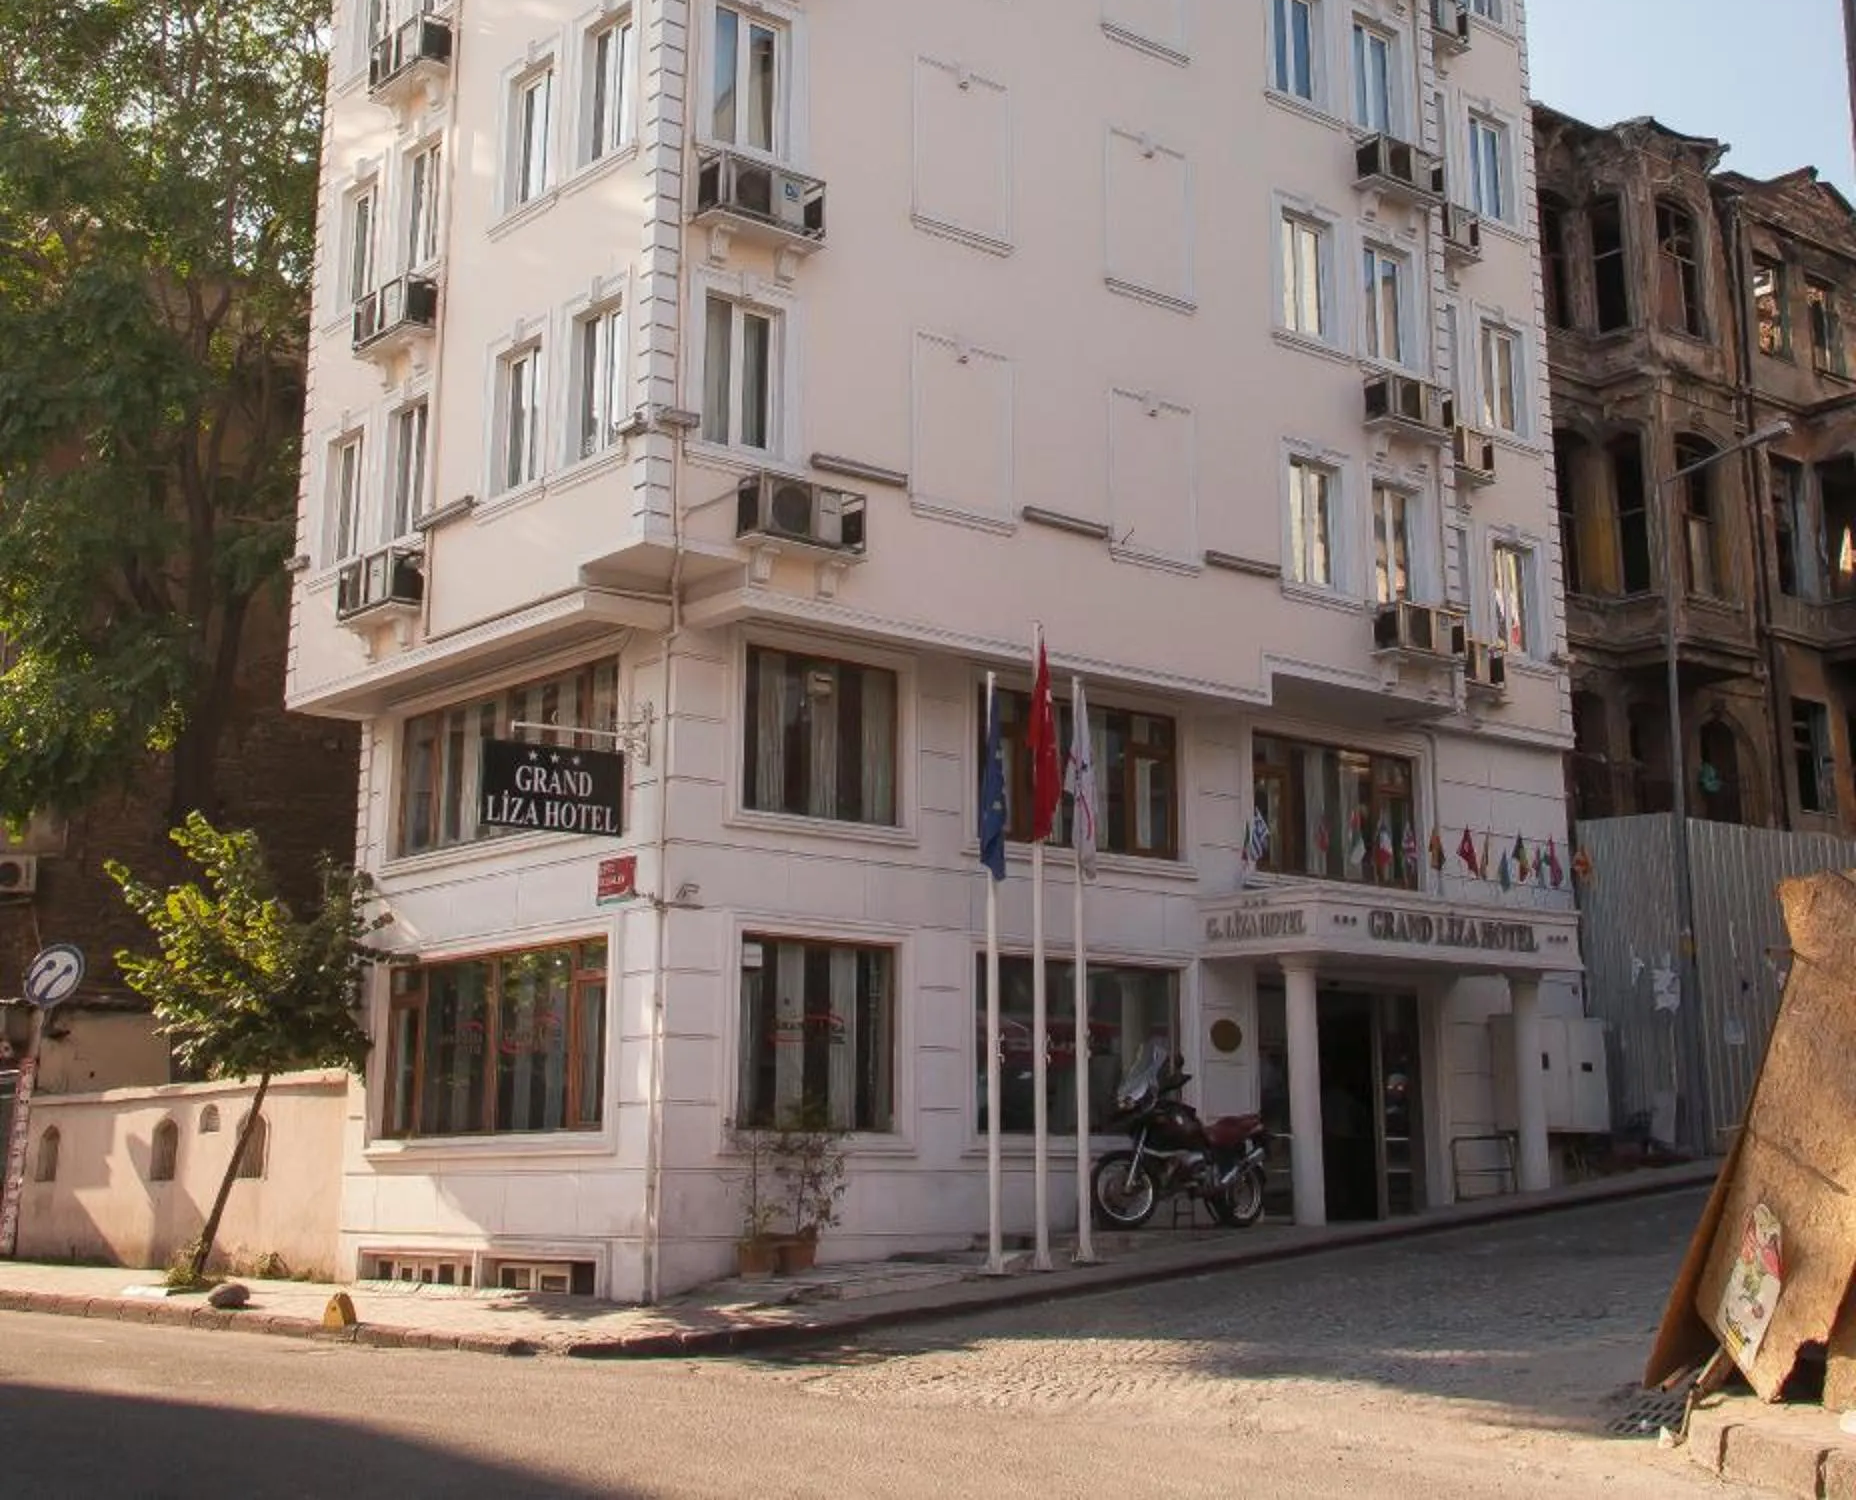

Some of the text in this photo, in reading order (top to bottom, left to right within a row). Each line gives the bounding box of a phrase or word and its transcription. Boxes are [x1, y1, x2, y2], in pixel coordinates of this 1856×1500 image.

[515, 765, 592, 797] GRAND
[487, 790, 618, 834] LİZA HOTEL
[1368, 909, 1433, 943] GRAND
[1480, 921, 1539, 952] HOTEL
